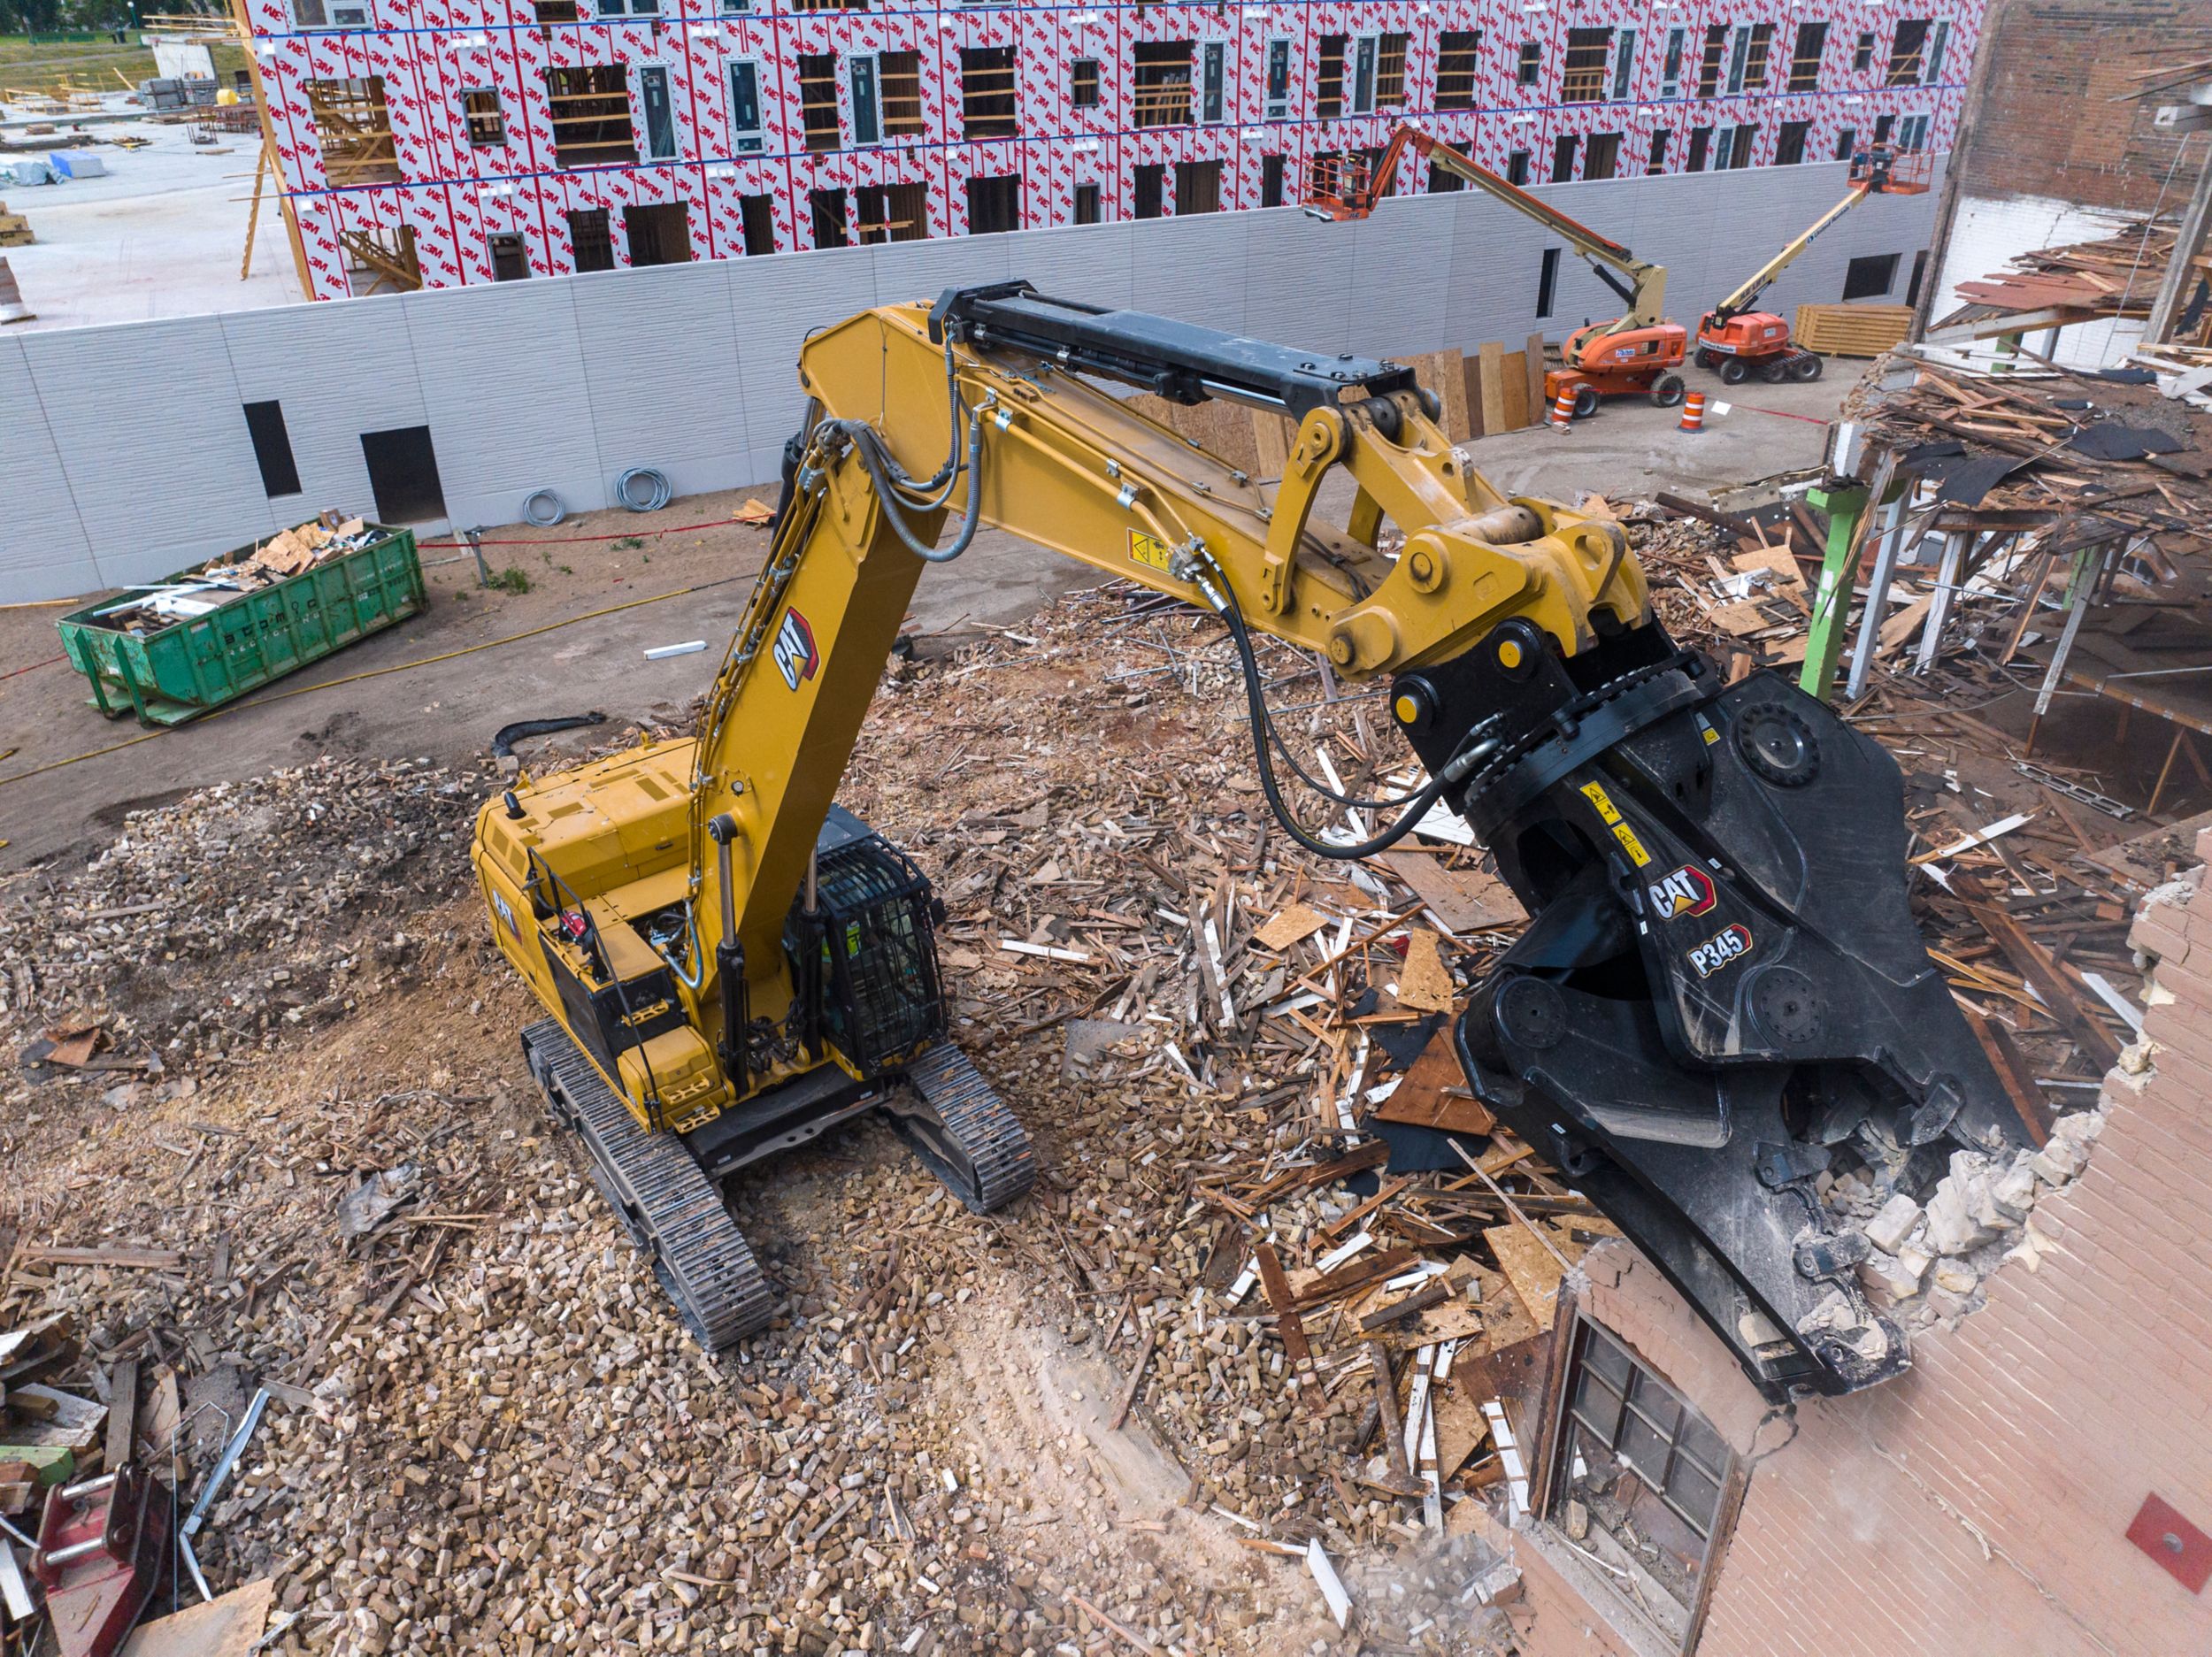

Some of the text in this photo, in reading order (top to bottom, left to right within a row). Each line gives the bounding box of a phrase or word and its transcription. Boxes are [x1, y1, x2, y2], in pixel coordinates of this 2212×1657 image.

[262, 4, 283, 21] 3M
[451, 8, 472, 26] 3M
[997, 12, 1012, 27] 3M
[1022, 13, 1035, 27] 3M
[1042, 11, 1056, 26] 3M
[426, 12, 446, 29] 3M
[777, 19, 794, 35] 3M
[850, 17, 865, 32] 3M
[871, 19, 887, 34] 3M
[967, 14, 981, 29] 3M
[811, 23, 827, 38] 3M
[889, 22, 903, 36] 3M
[989, 28, 1003, 42] 3M
[1059, 27, 1072, 41] 3M
[560, 32, 579, 49] 3M
[622, 30, 640, 46] 3M
[667, 37, 684, 53] 3M
[748, 30, 764, 47] 3M
[923, 34, 938, 49] 3M
[286, 39, 306, 57] 3M
[321, 38, 342, 55] 3M
[581, 42, 599, 58] 3M
[1023, 47, 1036, 61] 3M
[1043, 44, 1057, 59] 3M
[369, 50, 389, 68] 3M
[470, 52, 489, 67] 3M
[495, 48, 513, 65] 3M
[518, 49, 537, 65] 3M
[690, 53, 707, 68] 3M
[780, 56, 797, 72] 3M
[278, 60, 299, 78] 3M
[313, 58, 334, 76] 3M
[943, 59, 957, 74] 3M
[462, 72, 480, 88] 3M
[703, 71, 720, 88] 3M
[925, 69, 941, 84] 3M
[764, 86, 780, 101] 3M
[1044, 79, 1058, 93] 3M
[502, 86, 520, 104] 3M
[525, 88, 543, 104] 3M
[695, 89, 711, 105] 3M
[784, 92, 800, 106] 3M
[945, 94, 959, 109] 3M
[288, 102, 307, 119] 3M
[707, 107, 724, 123] 3M
[926, 103, 942, 119] 3M
[1045, 111, 1059, 126] 3M
[508, 124, 526, 142] 3M
[531, 125, 549, 142] 3M
[699, 126, 716, 141] 3M
[766, 120, 783, 136] 3M
[788, 126, 803, 142] 3M
[947, 127, 961, 142] 3M
[297, 142, 316, 158] 3M
[711, 142, 728, 158] 3M
[984, 149, 997, 163] 3M
[1026, 147, 1040, 161] 3M
[1050, 147, 1064, 161] 3M
[489, 158, 508, 175] 3M
[656, 166, 672, 181] 3M
[858, 161, 872, 176] 3M
[1035, 163, 1049, 178] 3M
[1059, 163, 1073, 177] 3M
[745, 172, 759, 188] 3M
[761, 170, 777, 184] 3M
[825, 168, 841, 183] 3M
[949, 168, 963, 182] 3M
[676, 177, 692, 194] 3M
[793, 176, 807, 191] 3M
[1027, 179, 1041, 193] 3M
[1051, 179, 1064, 193] 3M
[426, 188, 443, 203] 3M
[518, 188, 536, 203] 3M
[541, 189, 558, 204] 3M
[580, 189, 596, 204] 3M
[773, 186, 789, 201] 3M
[930, 184, 946, 199] 3M
[340, 197, 358, 214] 3M
[379, 201, 399, 217] 3M
[492, 197, 510, 212] 3M
[689, 196, 704, 211] 3M
[950, 200, 964, 214] 3M
[1035, 195, 1049, 209] 3M
[417, 206, 435, 223] 3M
[454, 210, 472, 226] 3M
[725, 206, 739, 221] 3M
[795, 210, 810, 225] 3M
[1028, 211, 1041, 225] 3M
[1052, 210, 1065, 224] 3M
[300, 219, 319, 235] 3M
[357, 215, 376, 232] 3M
[483, 216, 501, 232] 3M
[776, 220, 792, 235] 3M
[933, 217, 948, 231] 3M
[433, 224, 451, 242] 3M
[525, 224, 542, 240] 3M
[547, 225, 564, 240] 3M
[693, 230, 709, 245] 3M
[317, 237, 336, 253] 3M
[425, 243, 443, 259] 3M
[729, 241, 742, 255] 3M
[461, 246, 480, 263] 3M
[309, 257, 327, 272] 3M
[440, 260, 458, 278] 3M
[531, 258, 549, 274] 3M
[553, 260, 570, 275] 3M
[326, 273, 345, 290] 3M
[230, 611, 320, 656] RECYCLNG
[773, 612, 809, 690] CAT
[1648, 869, 1701, 918] CAT
[492, 890, 517, 934] CAT
[1690, 929, 1743, 975] P345
